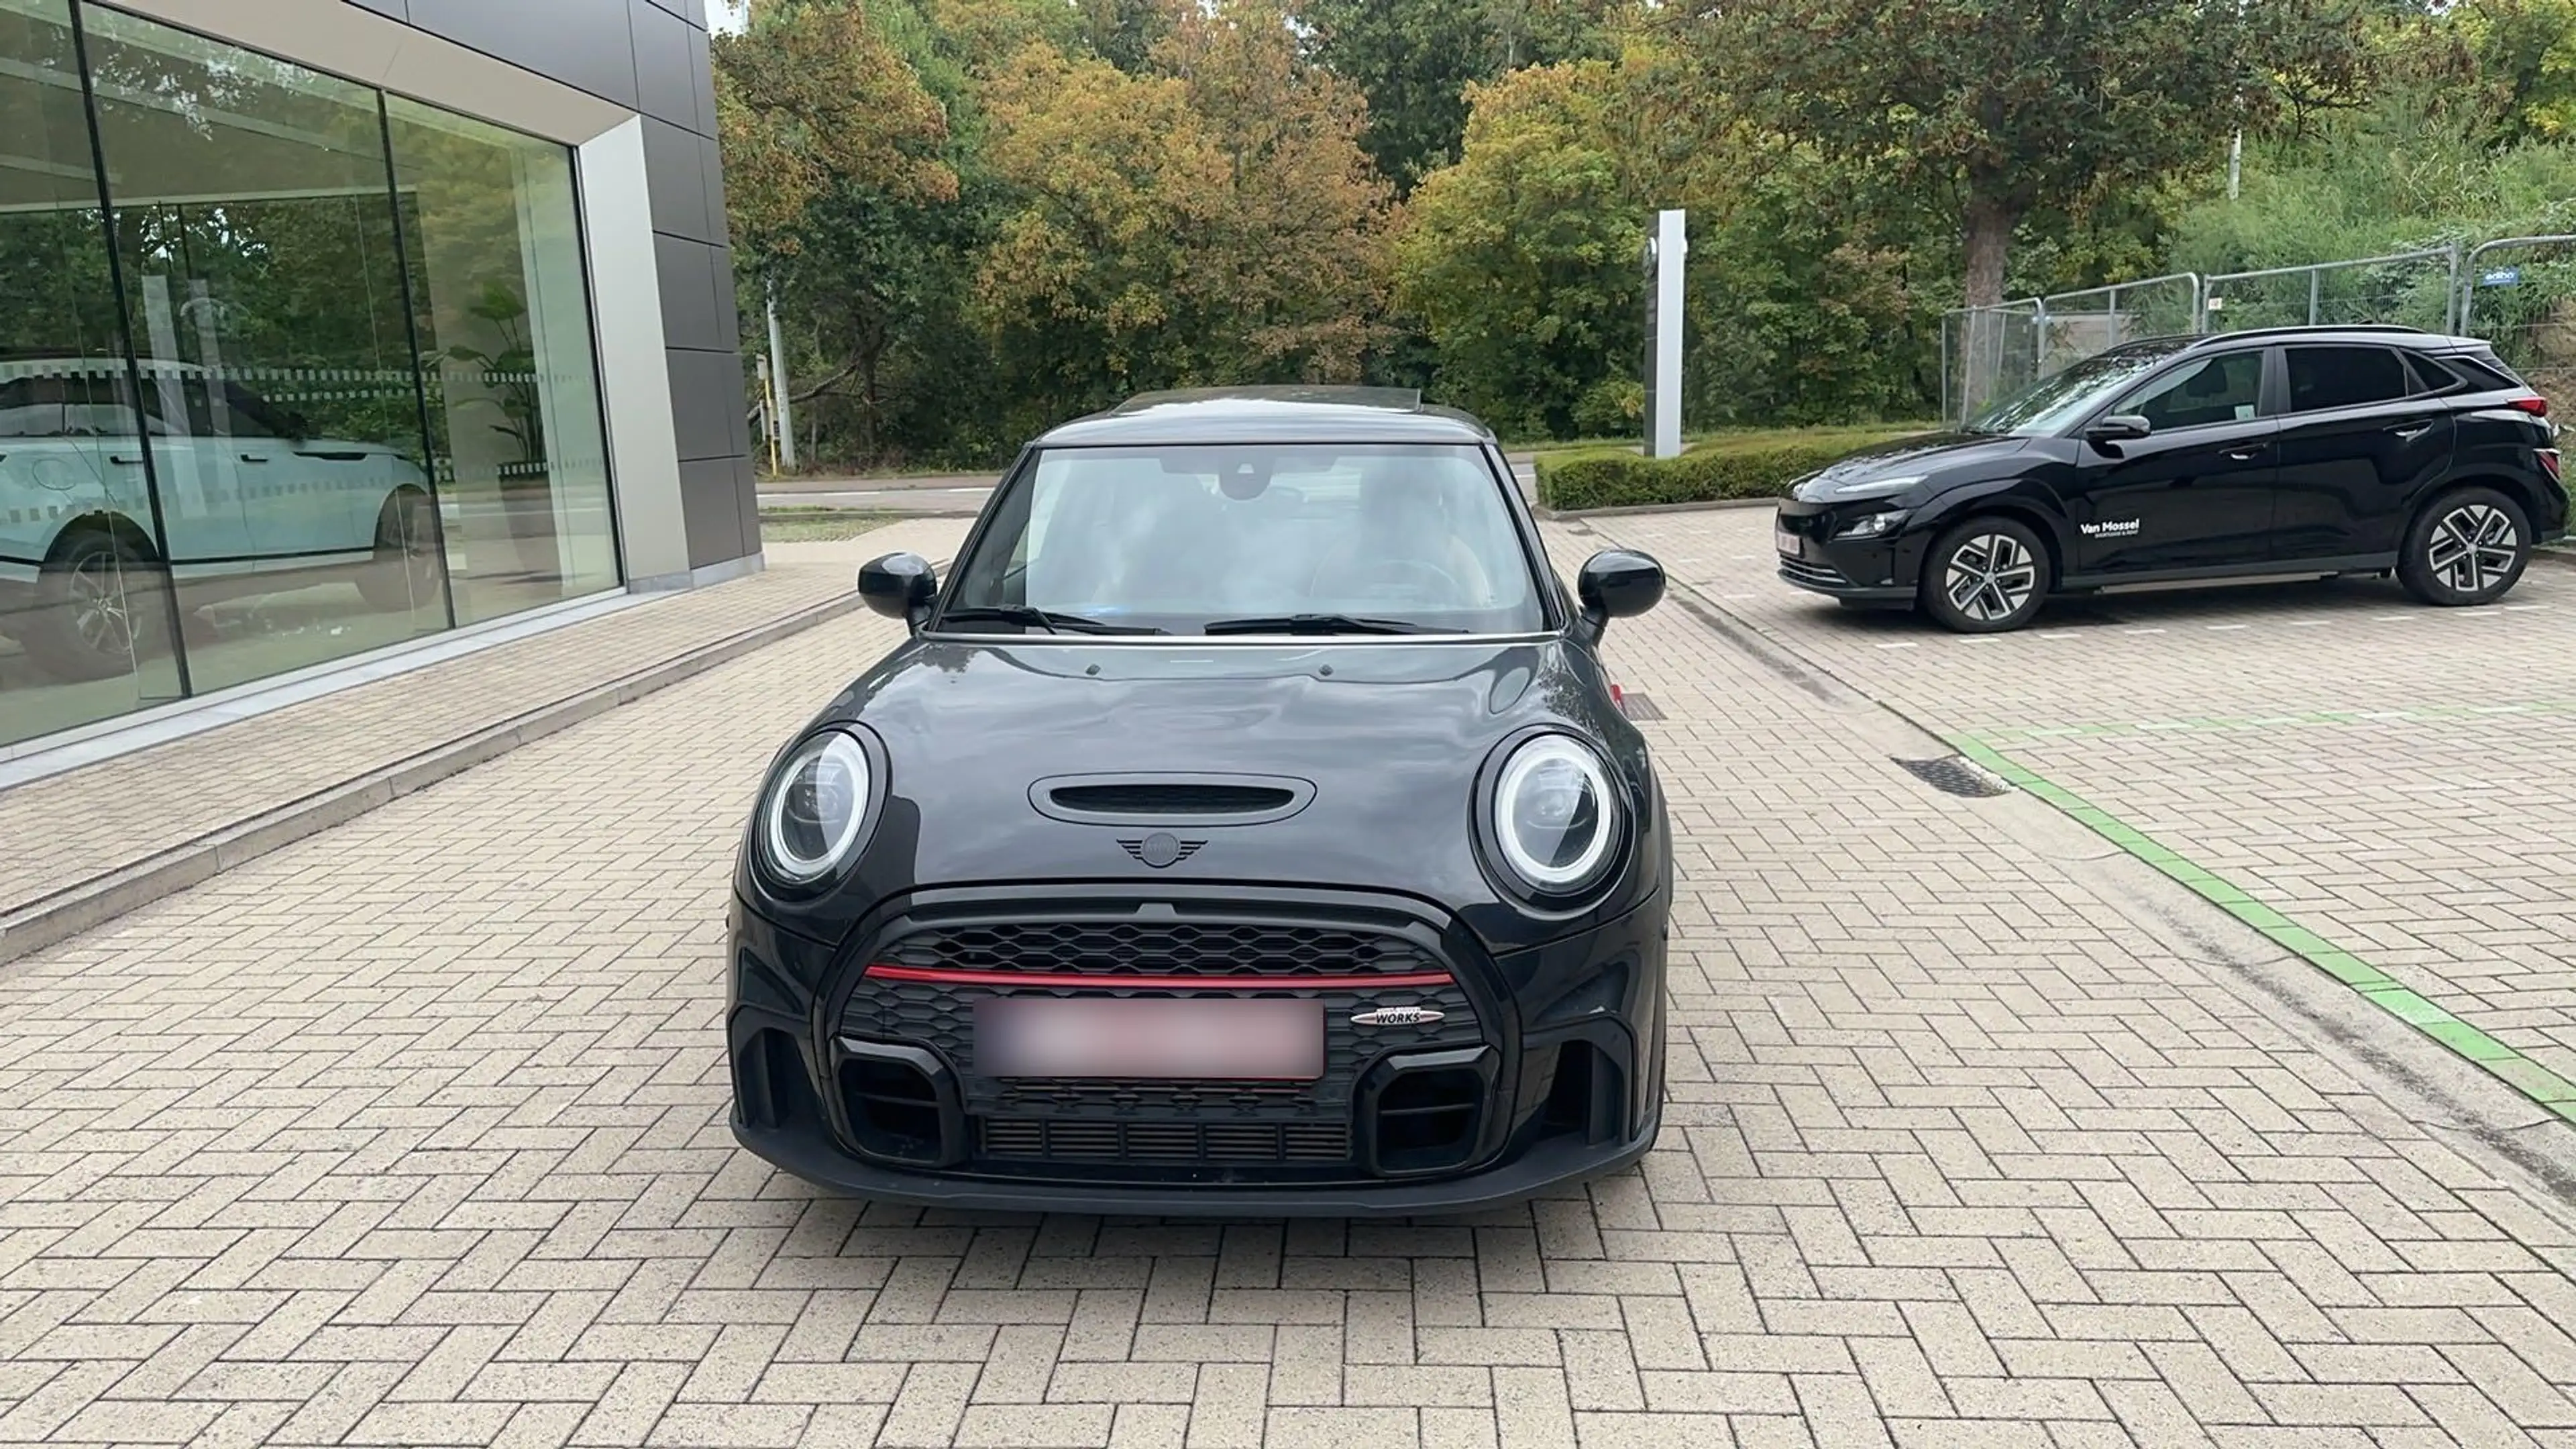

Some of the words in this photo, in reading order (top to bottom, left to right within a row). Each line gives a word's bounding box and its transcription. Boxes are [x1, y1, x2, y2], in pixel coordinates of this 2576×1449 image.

[2080, 523, 2100, 534] Van
[2102, 518, 2140, 532] Mossel
[1376, 1012, 1420, 1024] WORKS
